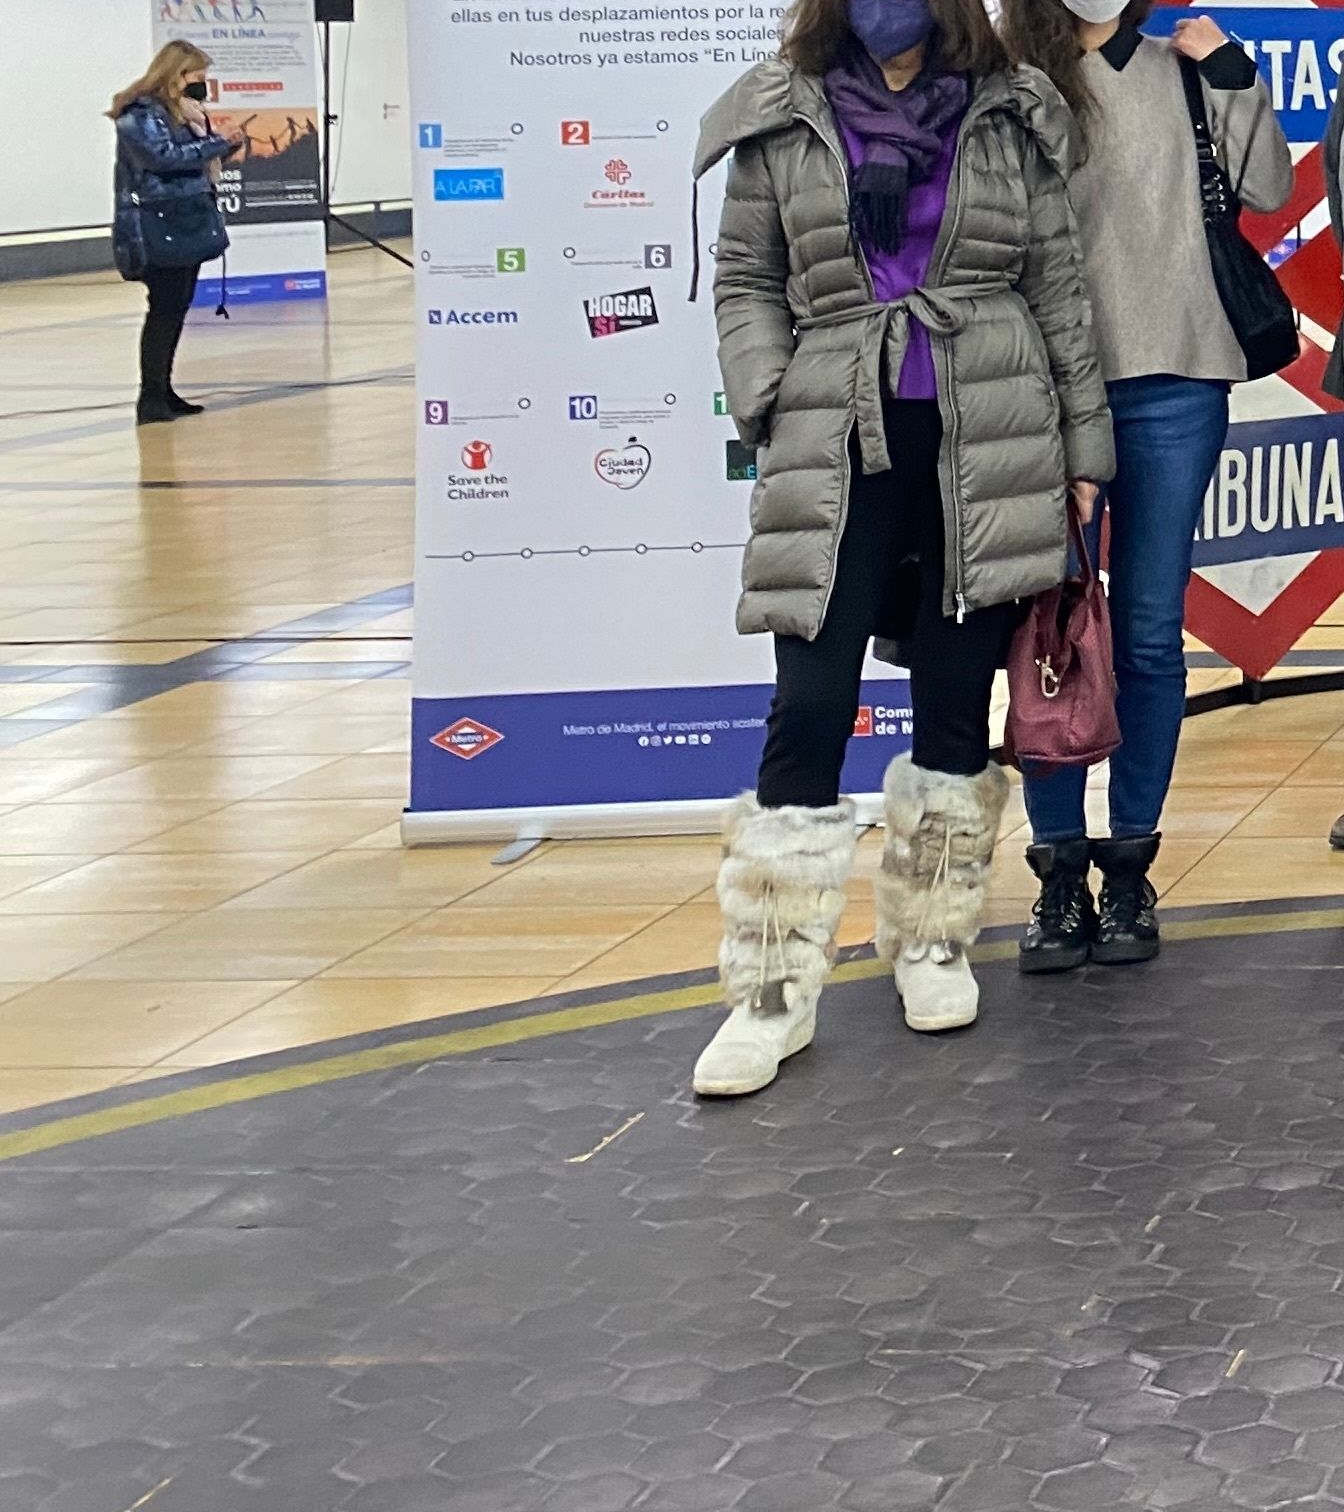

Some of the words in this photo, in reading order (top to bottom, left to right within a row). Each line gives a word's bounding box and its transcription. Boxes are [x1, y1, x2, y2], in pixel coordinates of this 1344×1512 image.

[450, 7, 492, 24] ellas
[498, 10, 520, 23] en
[525, 8, 553, 22] tus
[558, 5, 710, 25] desplazamientos
[714, 6, 745, 23] por
[749, 4, 764, 19] la
[579, 28, 655, 43] nuestras
[660, 27, 710, 42] redes
[509, 51, 592, 66] Nosotros
[597, 52, 619, 68] ya
[623, 50, 699, 64] estamos
[567, 123, 585, 144] 2
[503, 250, 519, 270] 5
[650, 246, 666, 267] 6
[587, 294, 653, 318] HOGAR
[446, 309, 519, 325] Accem
[428, 402, 444, 423] 9
[570, 397, 596, 418] 10
[447, 474, 482, 487] Save
[484, 473, 508, 485] the
[447, 488, 510, 501] Children
[874, 721, 897, 736] de
